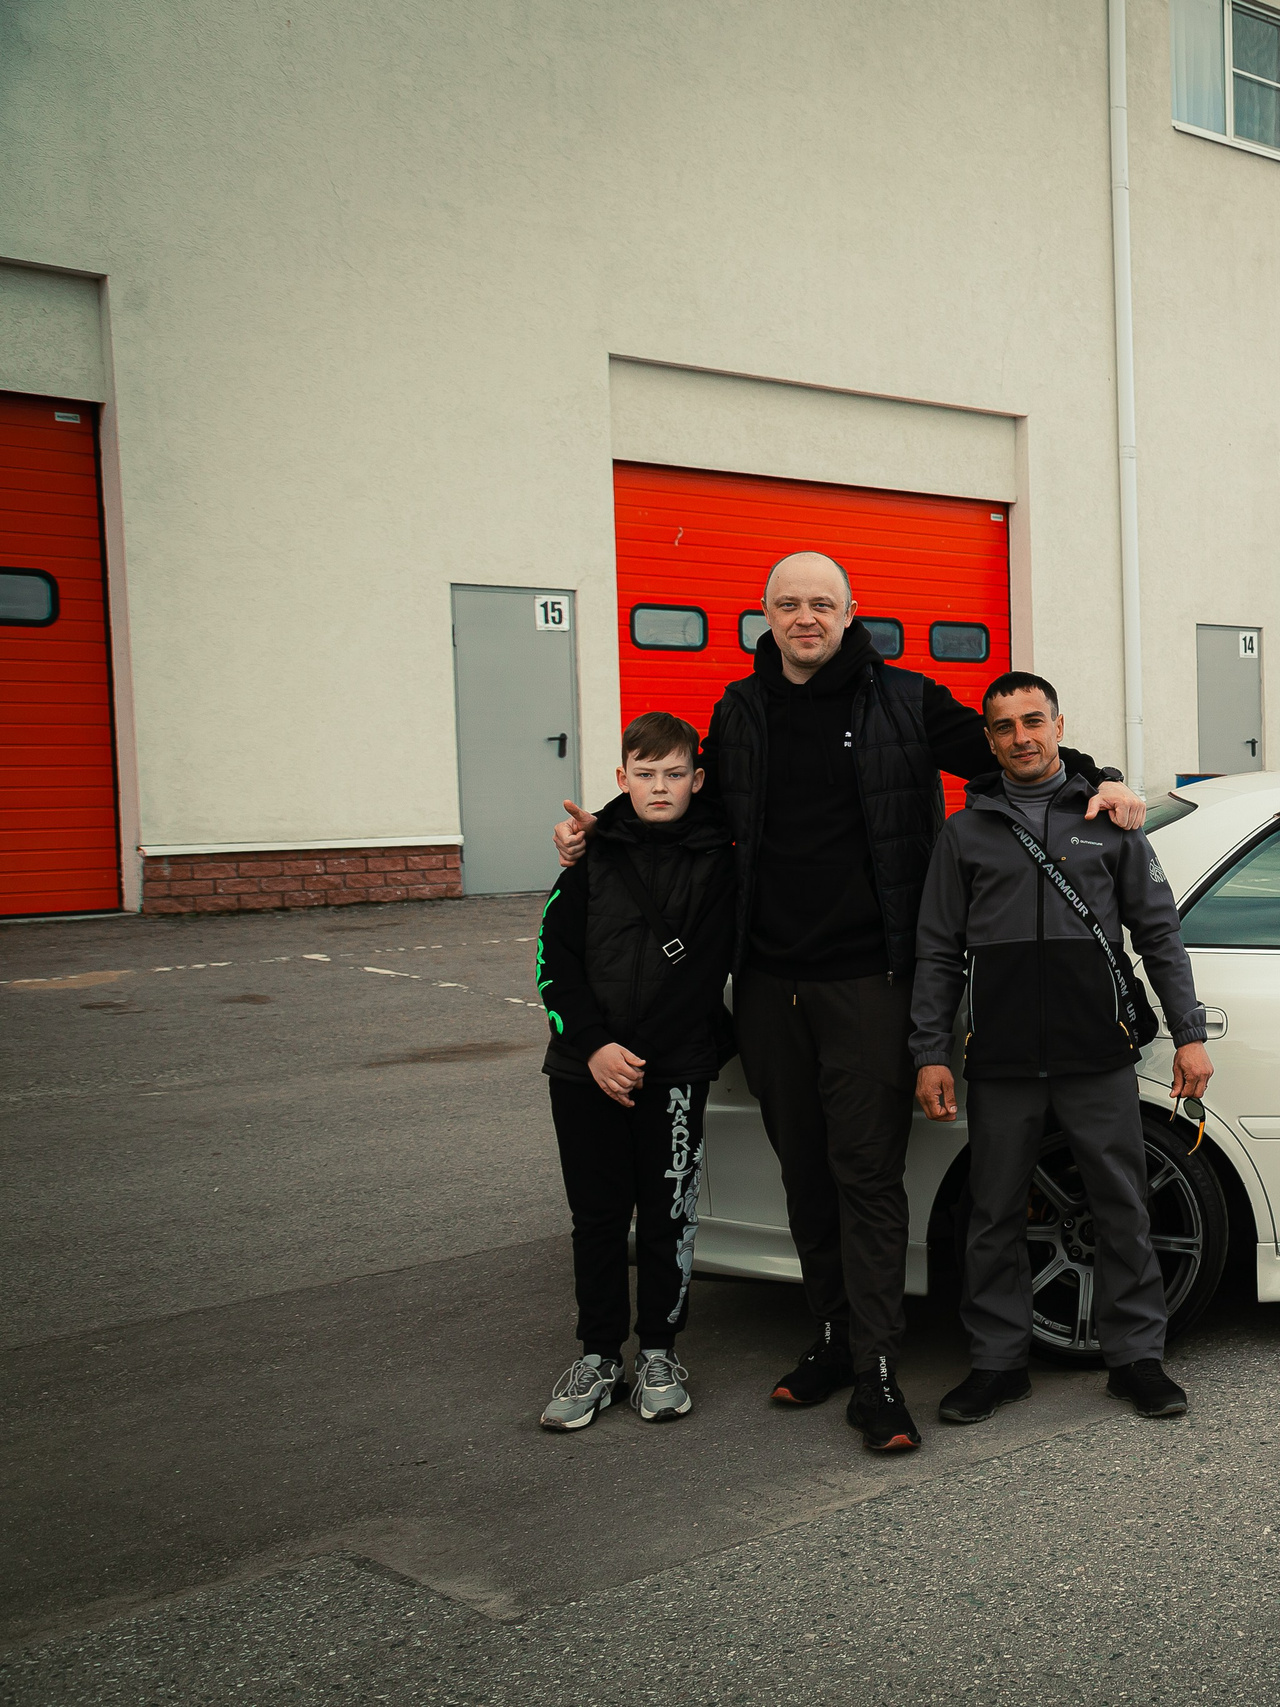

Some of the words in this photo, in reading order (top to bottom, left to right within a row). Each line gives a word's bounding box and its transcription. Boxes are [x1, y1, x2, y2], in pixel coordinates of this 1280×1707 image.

[540, 601, 563, 625] 15
[1242, 636, 1254, 653] 14
[1012, 823, 1046, 863] UNDER
[1043, 863, 1089, 917] ARMOUR
[1092, 923, 1117, 968] UNDER
[664, 1084, 693, 1219] NARUTO
